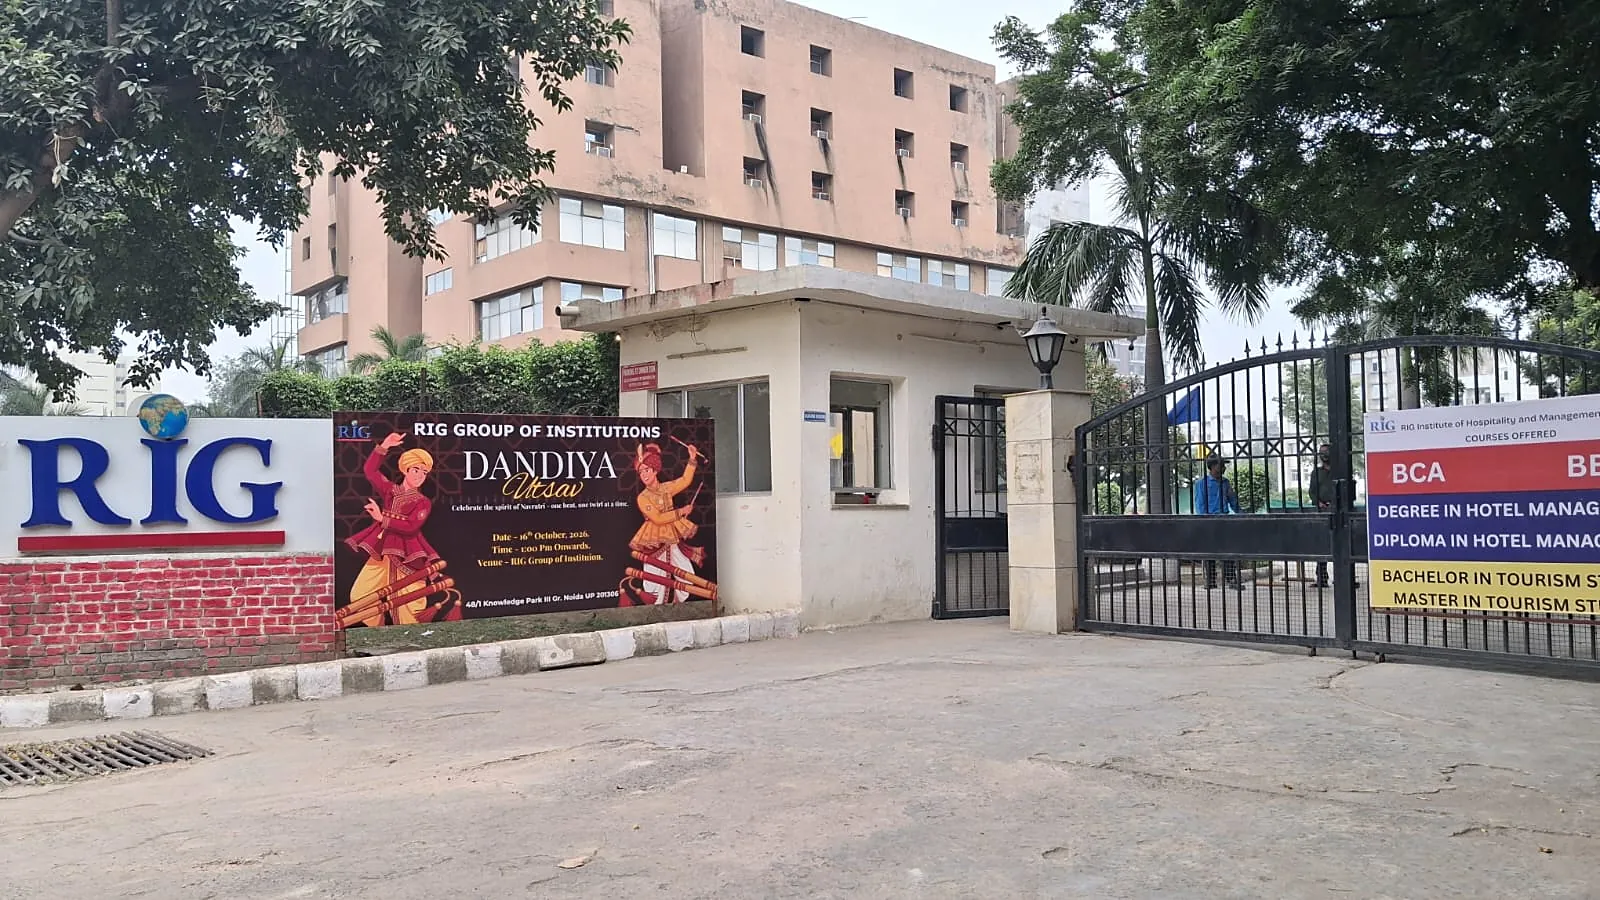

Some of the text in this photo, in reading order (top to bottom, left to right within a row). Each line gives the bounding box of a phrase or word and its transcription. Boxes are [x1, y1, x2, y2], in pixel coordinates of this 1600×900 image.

[414, 422, 661, 439] RIG GROUP OF INSTITUTIONS
[1401, 423, 1415, 431] RIG
[1417, 421, 1453, 430] Institute
[1455, 419, 1464, 428] of
[1466, 416, 1516, 428] Hospitality
[1518, 415, 1537, 423] and
[1465, 429, 1557, 443] COURSES OFFERED
[463, 450, 618, 480] DANDIYA
[1392, 462, 1446, 484] BCA
[502, 472, 584, 500] Utsav
[495, 503, 511, 511] spirit
[1378, 501, 1600, 518] DEGREE IN HOTEL MANAG
[492, 533, 512, 541] Date
[1373, 534, 1446, 547] DIPLOMA
[1450, 534, 1468, 547] IN
[1473, 534, 1531, 548] HOTEL
[492, 545, 513, 554] Time
[540, 544, 552, 552] Pm
[554, 542, 591, 551] Onwards.
[477, 559, 503, 567] Venue
[511, 557, 527, 566] RIG
[528, 556, 553, 566] Group
[555, 555, 564, 563] of
[1382, 570, 1600, 588] BACHELOR IN TOURISM S
[465, 600, 482, 608] 48/1
[483, 598, 525, 607] Knowledge
[525, 596, 542, 604] Park
[563, 593, 584, 601] Noida
[596, 590, 619, 598] 201306
[1394, 592, 1458, 607] MASTER
[1463, 595, 1481, 608] IN
[1486, 596, 1569, 611] TOURISM
